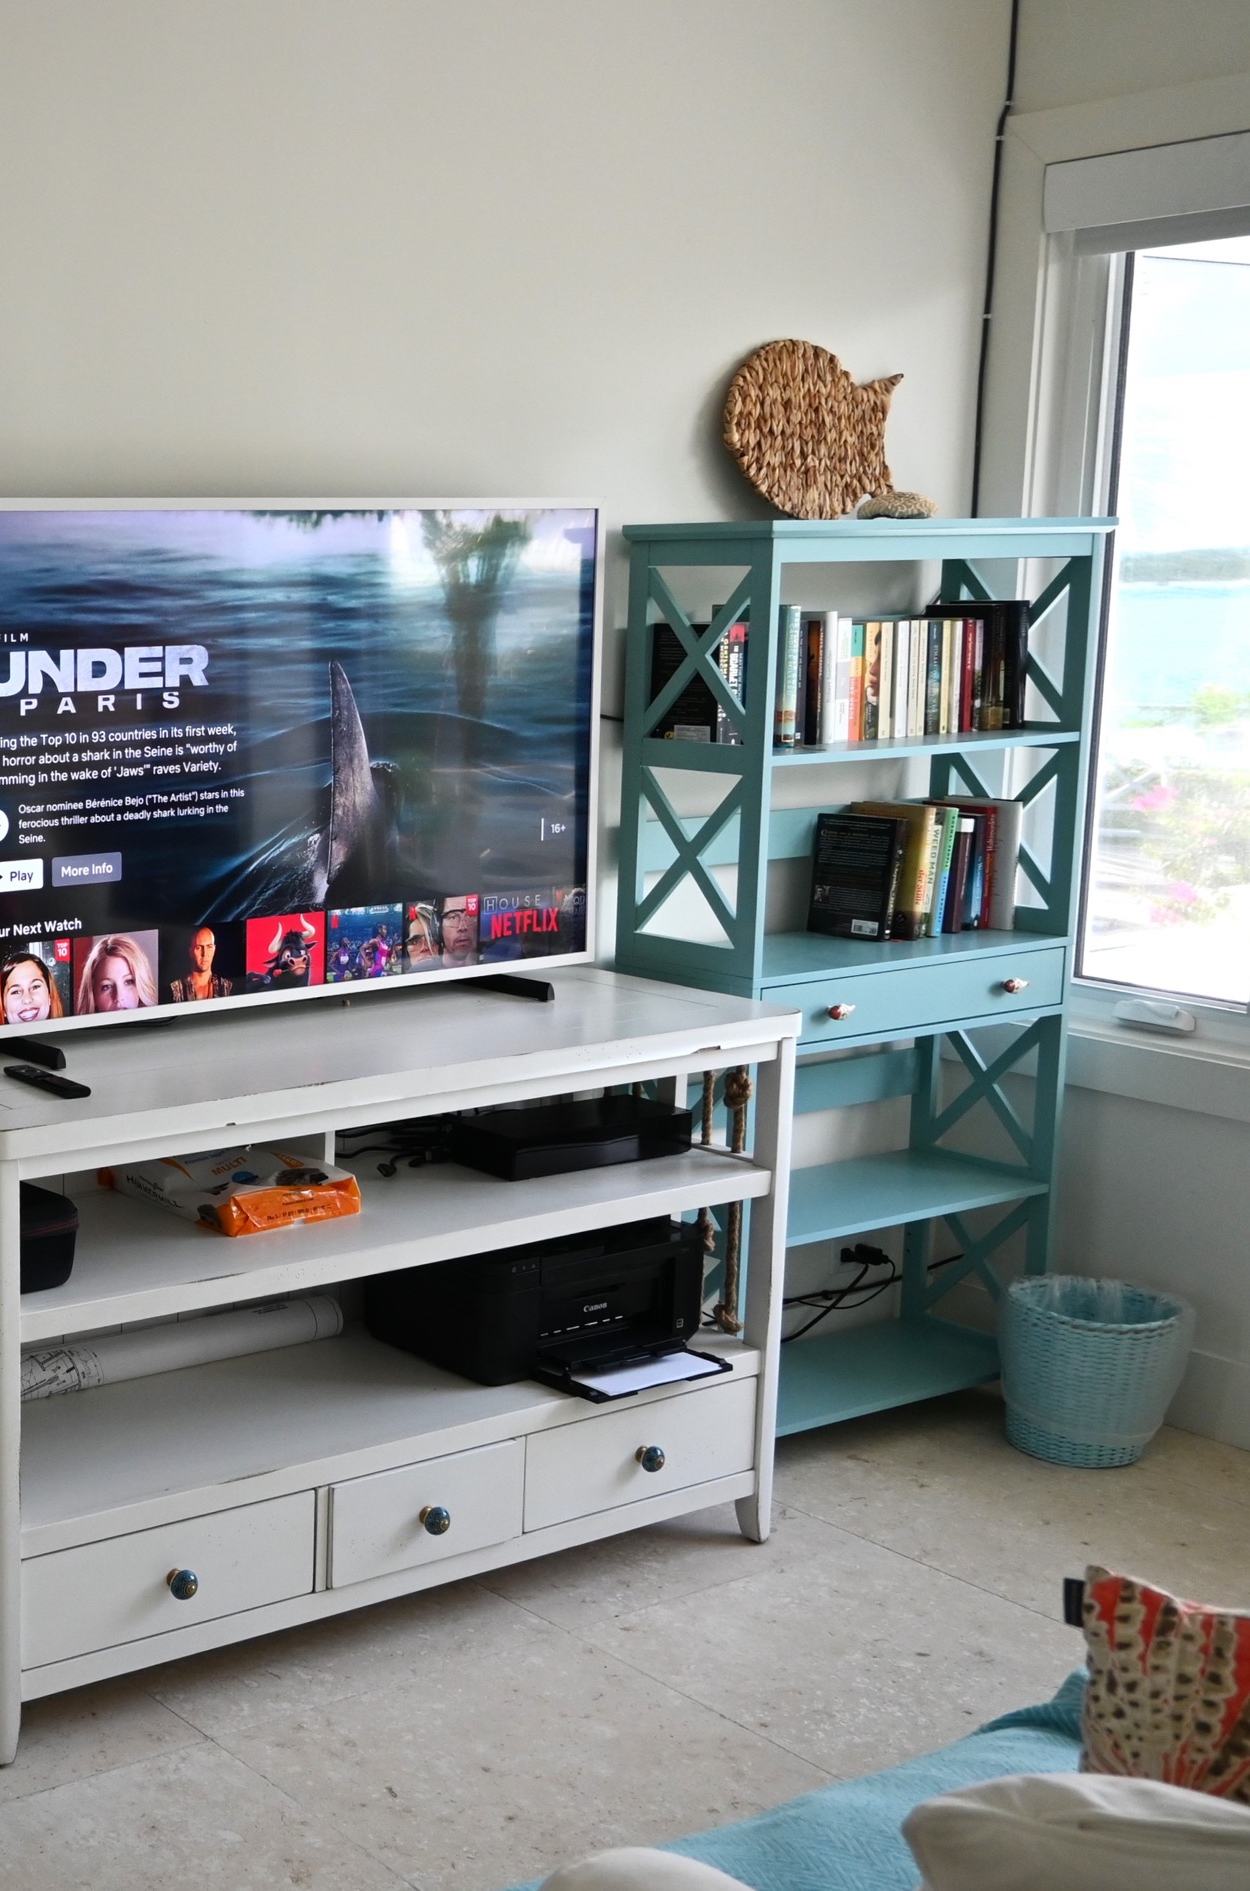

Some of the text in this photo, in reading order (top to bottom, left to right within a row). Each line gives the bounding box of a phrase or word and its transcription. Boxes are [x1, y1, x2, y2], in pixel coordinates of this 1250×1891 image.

[20, 691, 180, 716] PARIS
[19, 735, 38, 747] the
[40, 734, 62, 748] Top
[64, 732, 77, 744] 10
[79, 732, 89, 743] in
[91, 731, 106, 743] 93
[108, 728, 157, 741] countries
[159, 727, 169, 739] in
[171, 727, 183, 738] its
[185, 725, 205, 737] first
[207, 723, 237, 737] week,
[2, 755, 36, 767] horror
[38, 751, 70, 765] about
[72, 753, 79, 762] a
[81, 748, 110, 761] shark
[112, 748, 122, 759] in
[125, 747, 141, 758] the
[144, 745, 173, 757] Seine
[175, 745, 184, 756] is
[186, 742, 225, 755] "worthy
[227, 740, 237, 752] of
[38, 771, 48, 783] in
[50, 770, 68, 782] the
[70, 768, 98, 780] wake
[100, 766, 112, 779] of
[153, 763, 181, 775] raves
[183, 760, 222, 773] Variety.
[18, 804, 44, 814] Oscar
[46, 801, 83, 812] nominee
[85, 797, 123, 809] Bérénice
[125, 796, 144, 807] Bejo
[200, 790, 220, 800] stars
[221, 789, 228, 799] in
[229, 788, 245, 798] this
[18, 804, 229, 829] ferocious thriller about a deadly shark lurking in the
[550, 822, 566, 834] 16+
[18, 833, 46, 844] Seine.
[930, 828, 940, 859] WEED
[9, 870, 34, 884] Play
[61, 863, 113, 878] More Info
[927, 861, 936, 885] MAN
[484, 894, 541, 914] HOUSE
[13, 922, 42, 936] Next
[44, 918, 82, 932] Watch
[491, 908, 558, 939] NETFLIX
[57, 948, 67, 957] 10
[583, 1301, 607, 1313] Canon
